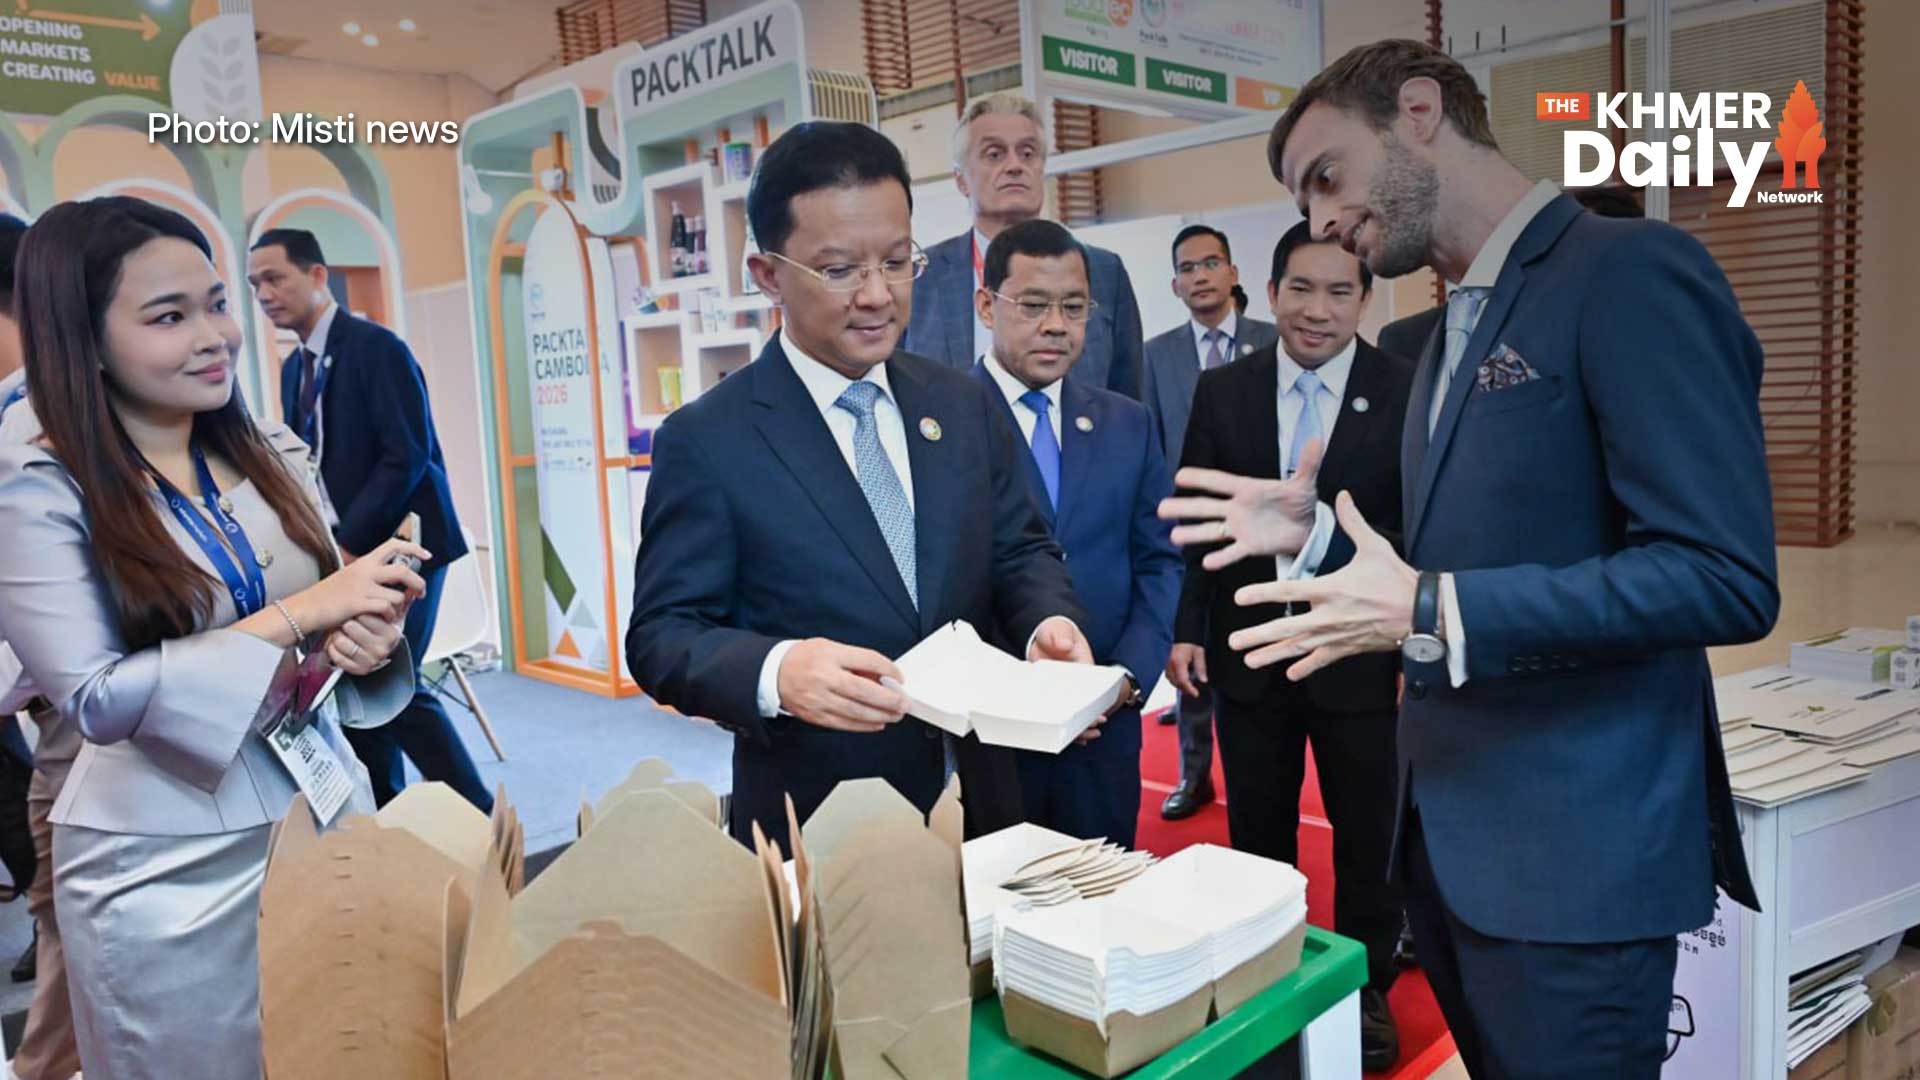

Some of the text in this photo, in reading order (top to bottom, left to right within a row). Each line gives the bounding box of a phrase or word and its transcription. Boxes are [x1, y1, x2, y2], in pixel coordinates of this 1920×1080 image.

[0, 16, 83, 40] OPENING
[0, 38, 92, 63] MARKETS
[631, 13, 776, 107] PACKTALK
[1060, 46, 1118, 76] VISITOR
[2, 60, 161, 91] CREATING VALUE
[1162, 69, 1212, 93] VISITOR
